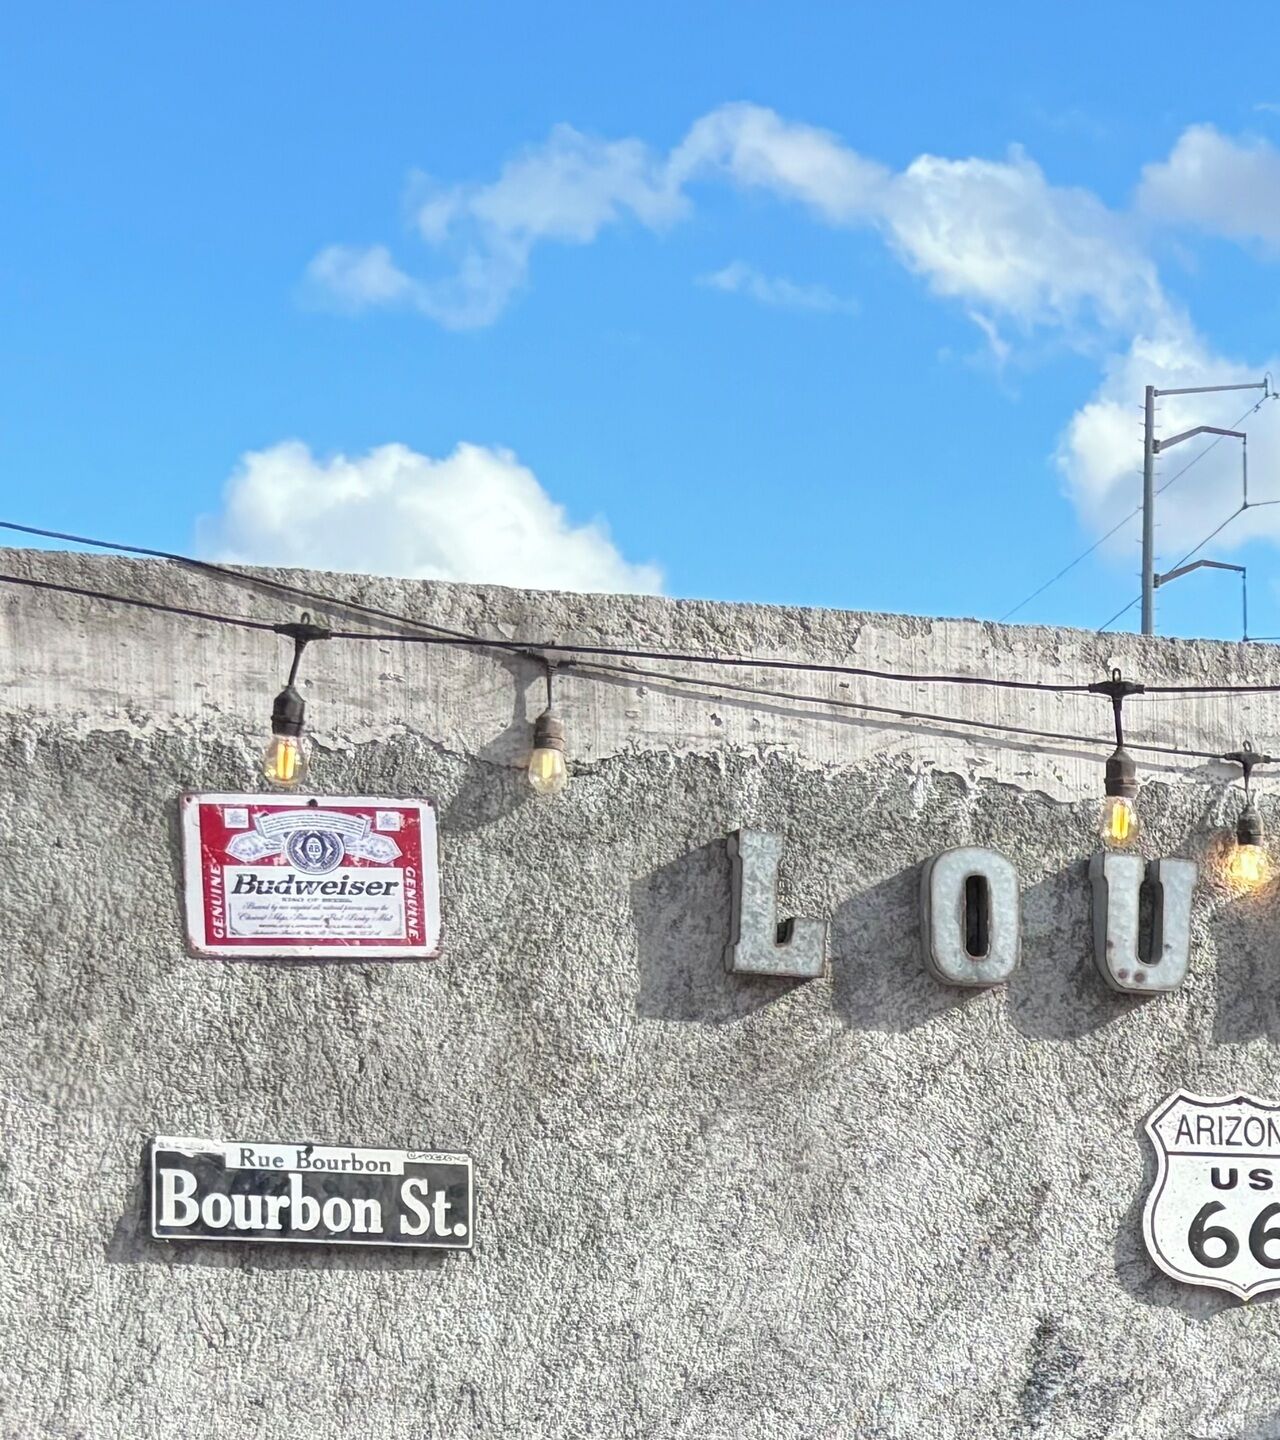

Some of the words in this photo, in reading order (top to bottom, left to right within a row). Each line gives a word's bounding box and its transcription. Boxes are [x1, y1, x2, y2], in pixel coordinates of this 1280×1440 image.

[209, 863, 224, 939] GENUINE
[231, 874, 399, 897] Budweiser
[404, 865, 419, 940] GENUINE
[239, 1147, 284, 1168] Rue
[296, 1147, 392, 1173] Bourbon
[1210, 1167, 1274, 1191] US
[158, 1168, 384, 1233] Bourbon
[400, 1177, 468, 1237] St.
